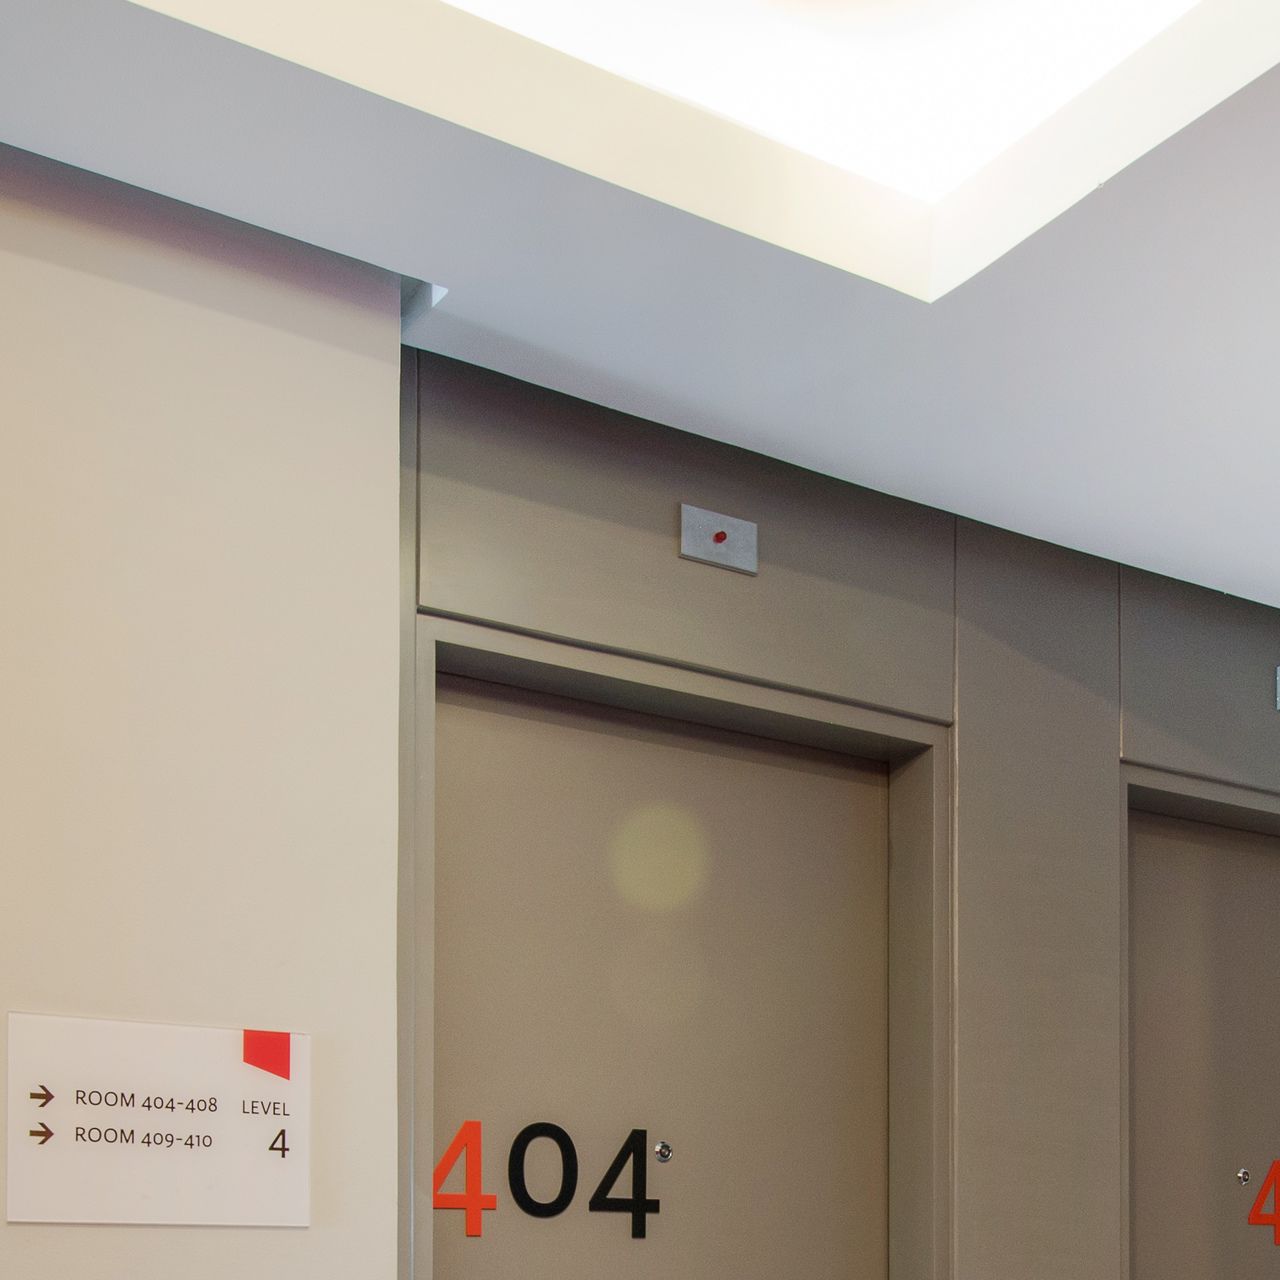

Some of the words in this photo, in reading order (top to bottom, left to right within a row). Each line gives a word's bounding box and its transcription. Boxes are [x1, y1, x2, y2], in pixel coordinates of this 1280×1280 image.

[75, 1090, 135, 1108] ROOM
[141, 1096, 218, 1113] 404-408
[242, 1100, 290, 1116] LEVEL
[75, 1127, 135, 1144] ROOM
[141, 1132, 213, 1149] 409-410
[268, 1129, 290, 1158] 4
[432, 1120, 660, 1238] 404
